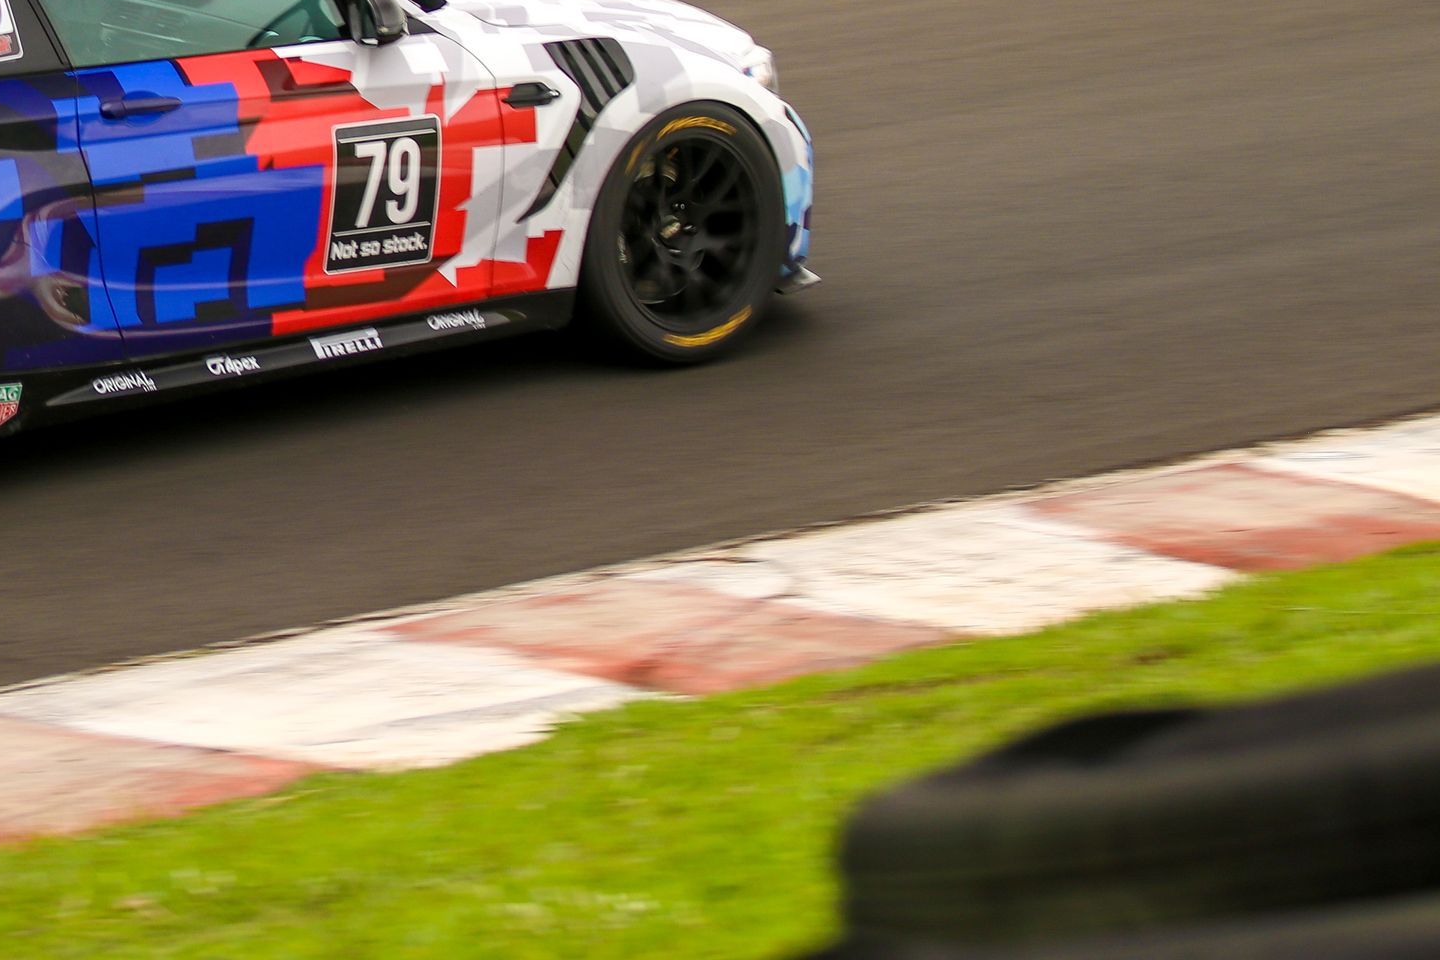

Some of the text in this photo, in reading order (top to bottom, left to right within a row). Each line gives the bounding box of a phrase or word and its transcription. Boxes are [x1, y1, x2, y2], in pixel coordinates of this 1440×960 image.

[354, 136, 421, 228] 79
[330, 231, 427, 260] Not so stock.
[310, 327, 384, 360] PIRELLI
[92, 369, 155, 394] ORIGINAL
